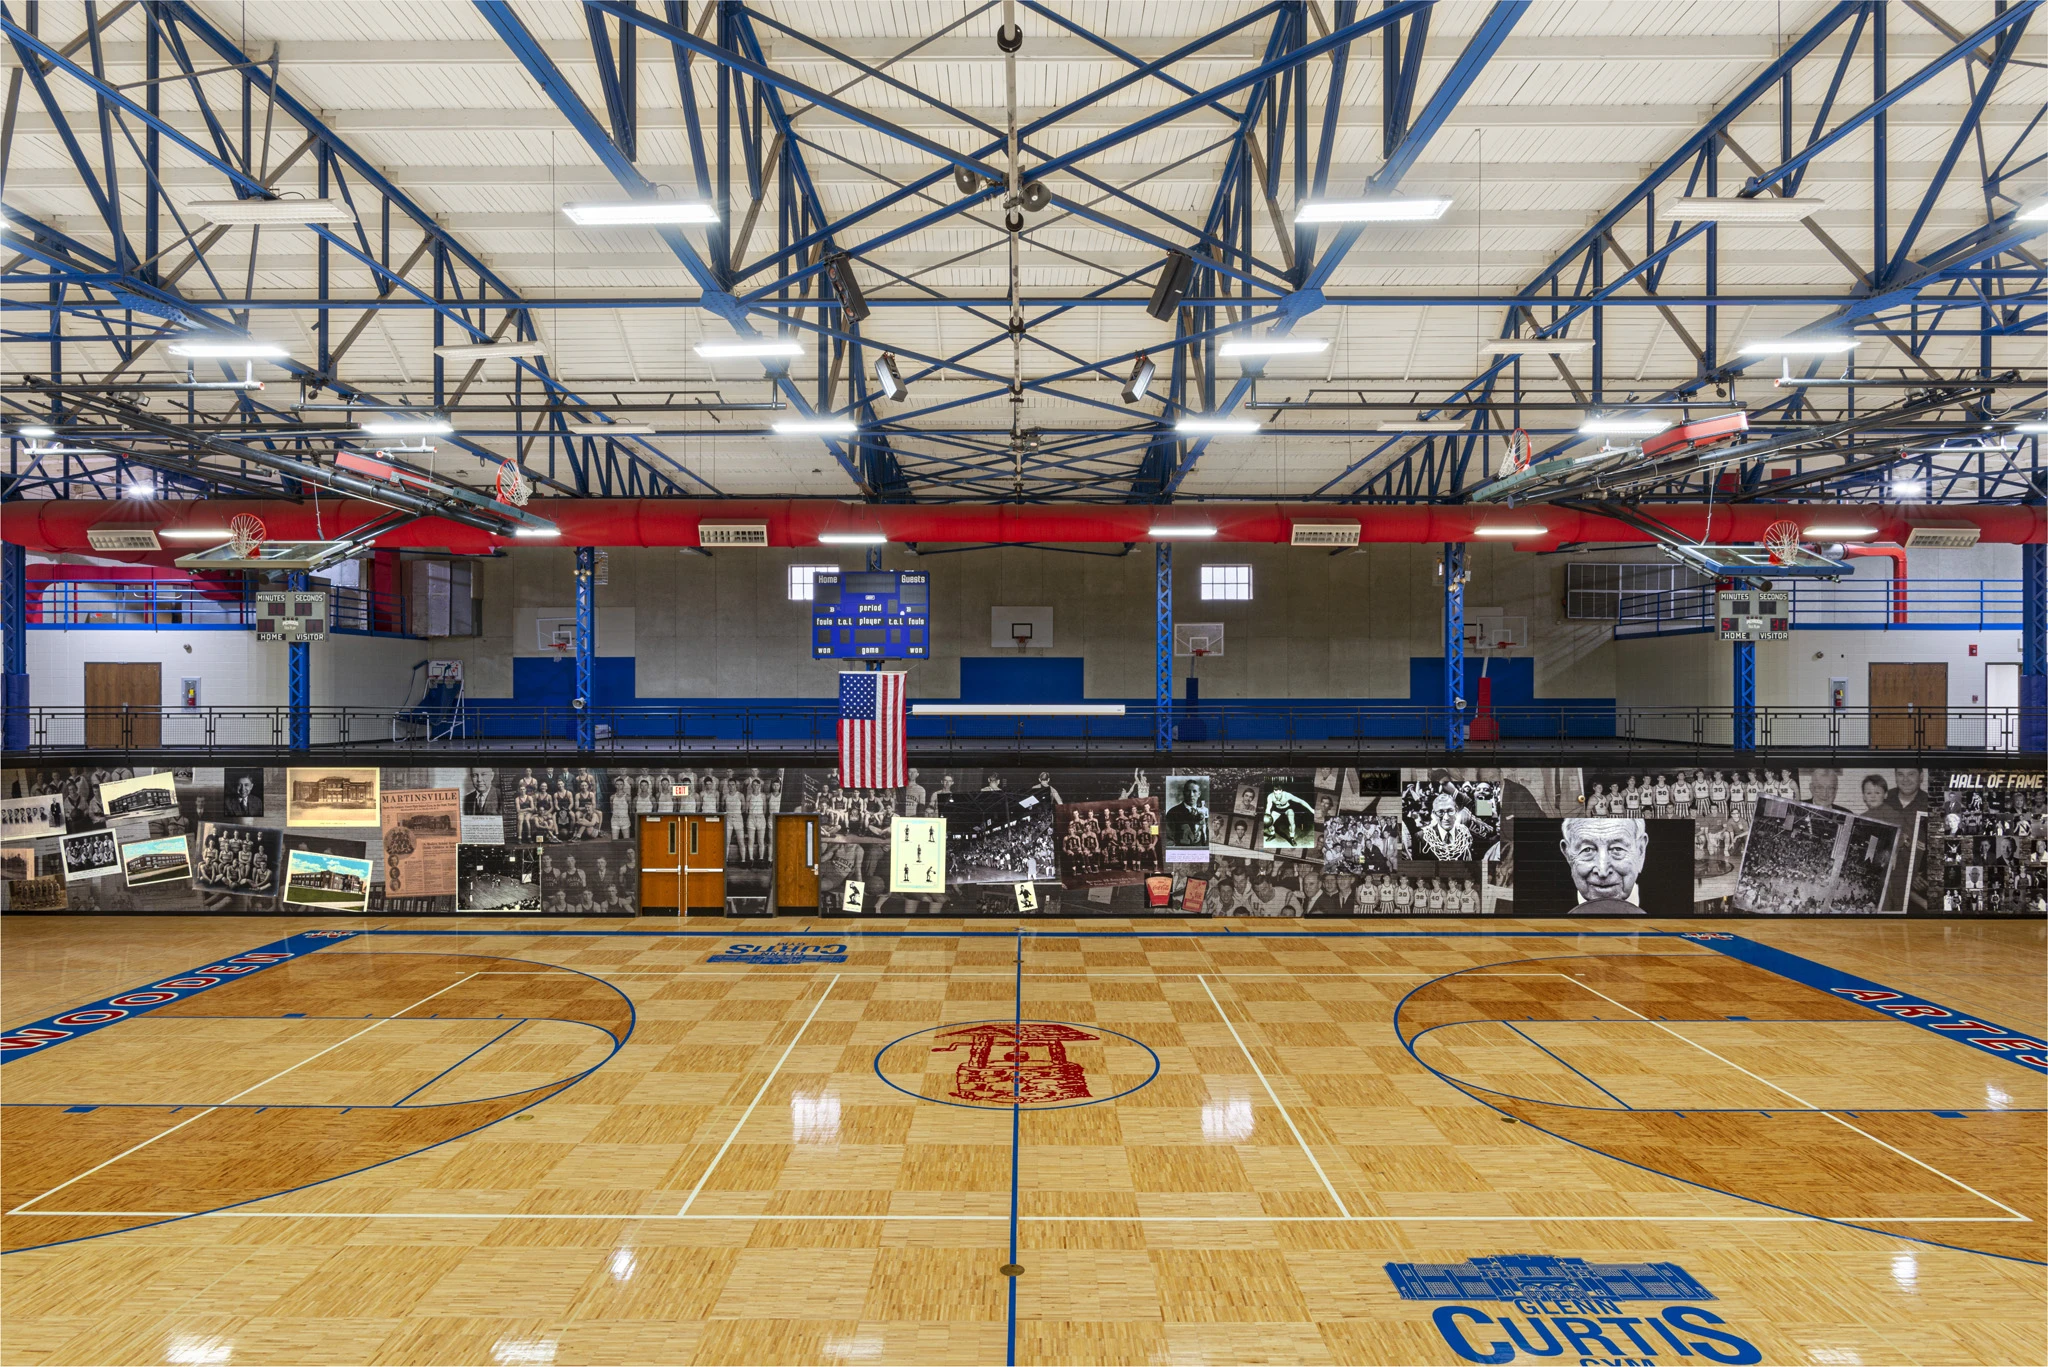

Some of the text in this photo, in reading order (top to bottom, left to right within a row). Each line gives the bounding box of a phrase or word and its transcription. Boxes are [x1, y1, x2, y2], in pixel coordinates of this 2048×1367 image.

[818, 575, 838, 584] Home
[901, 574, 925, 583] Guests
[859, 604, 882, 613] period
[859, 617, 882, 625] player
[1949, 774, 2045, 788] HALL OF FAME
[675, 786, 686, 795] EXIT
[382, 792, 457, 803] MARTINSVILLE
[0, 953, 294, 1050] WOODEN
[1512, 1298, 1624, 1315] GLENN
[1432, 1305, 1762, 1366] CURTIS
